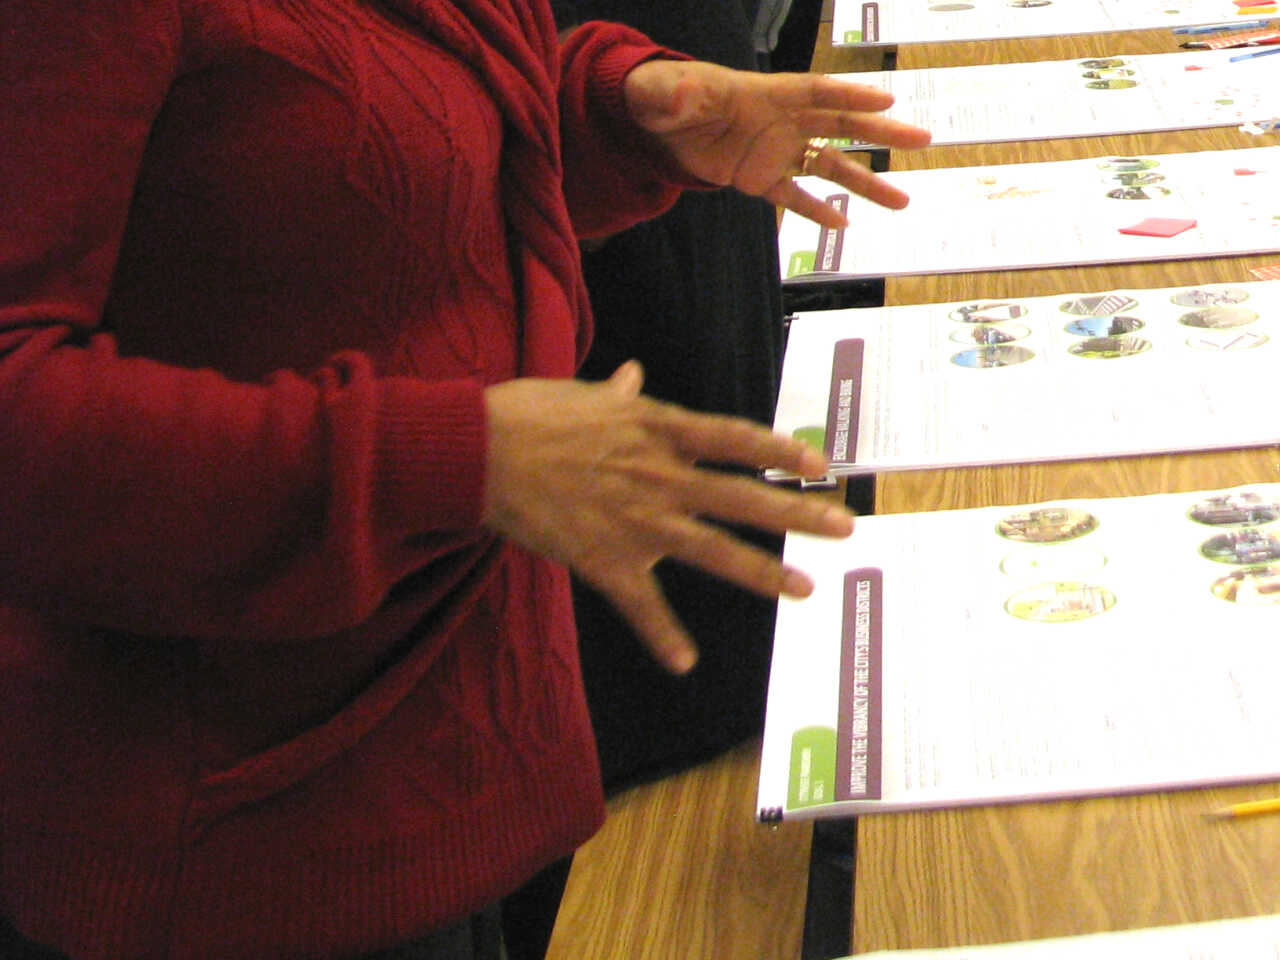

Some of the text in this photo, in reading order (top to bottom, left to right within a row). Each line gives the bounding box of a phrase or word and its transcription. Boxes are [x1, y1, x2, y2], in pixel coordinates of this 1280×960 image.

[854, 668, 869, 684] THE
[853, 685, 869, 697] OF
[852, 697, 868, 738] VIBRANCY
[851, 738, 867, 755] THE
[850, 755, 867, 794] IMPROVE
